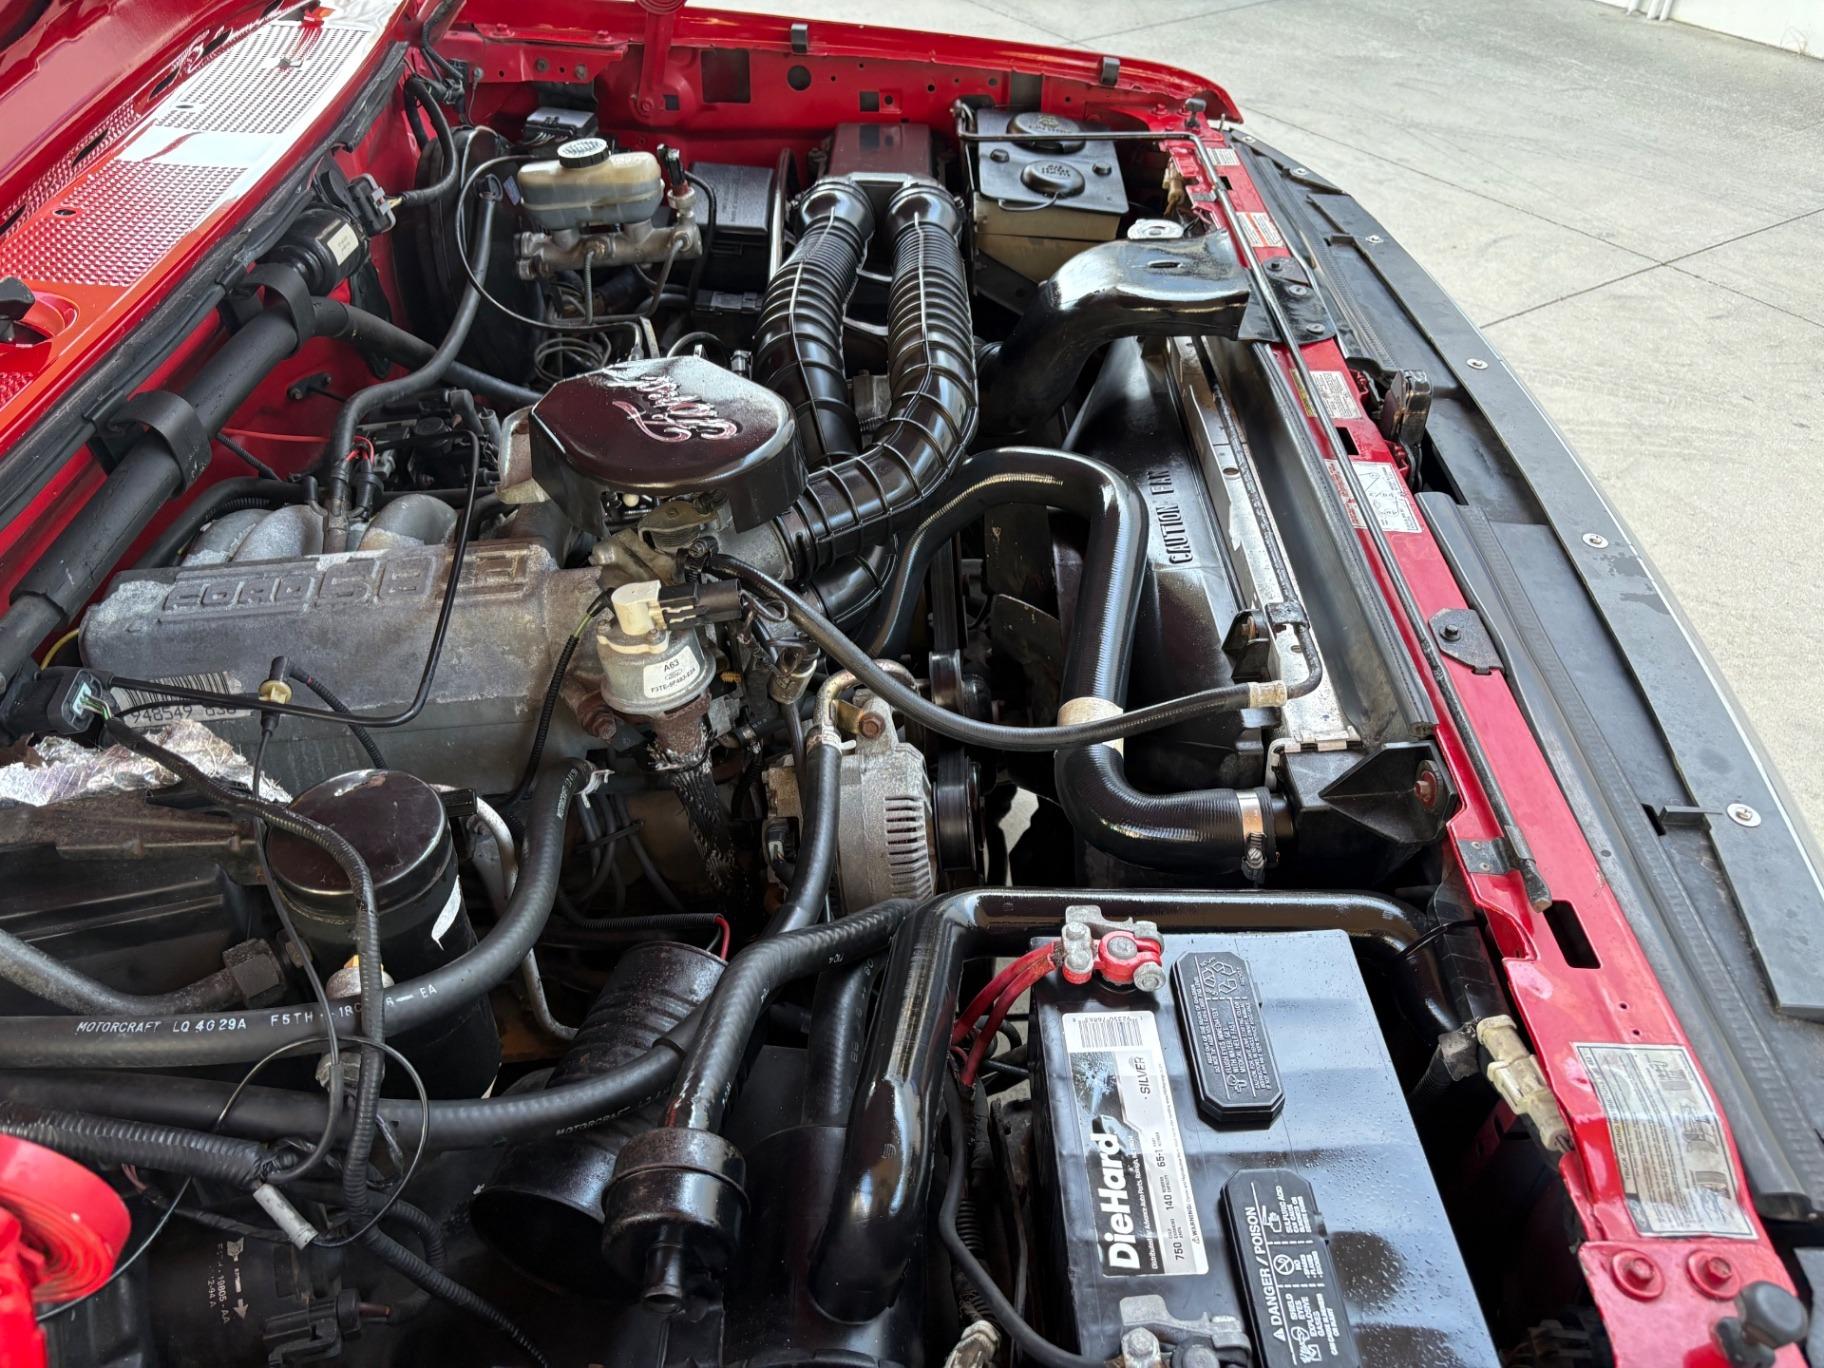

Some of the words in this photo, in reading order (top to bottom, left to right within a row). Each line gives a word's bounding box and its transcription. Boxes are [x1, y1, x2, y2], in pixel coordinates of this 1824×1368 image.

[1147, 470, 1174, 495] FAN
[1155, 504, 1193, 564] CAUTION
[664, 660, 679, 672] A63
[419, 984, 438, 999] EA
[75, 1021, 162, 1033] MOTORCRAFT
[1135, 1056, 1152, 1094] SILVER
[1091, 1132, 1141, 1271] DieHard
[1165, 1194, 1174, 1210] 140
[1275, 1185, 1285, 1200] ACID
[1280, 1201, 1294, 1233] SULFURIC
[1245, 1207, 1266, 1253] POISON
[1174, 1242, 1184, 1260] 750
[1293, 1259, 1302, 1270] NO
[1259, 1268, 1283, 1325] DANGER
[1295, 1300, 1306, 1319] EYES
[1302, 1296, 1318, 1336] EXPLOSIVE
[1312, 1310, 1326, 1336] GASES
